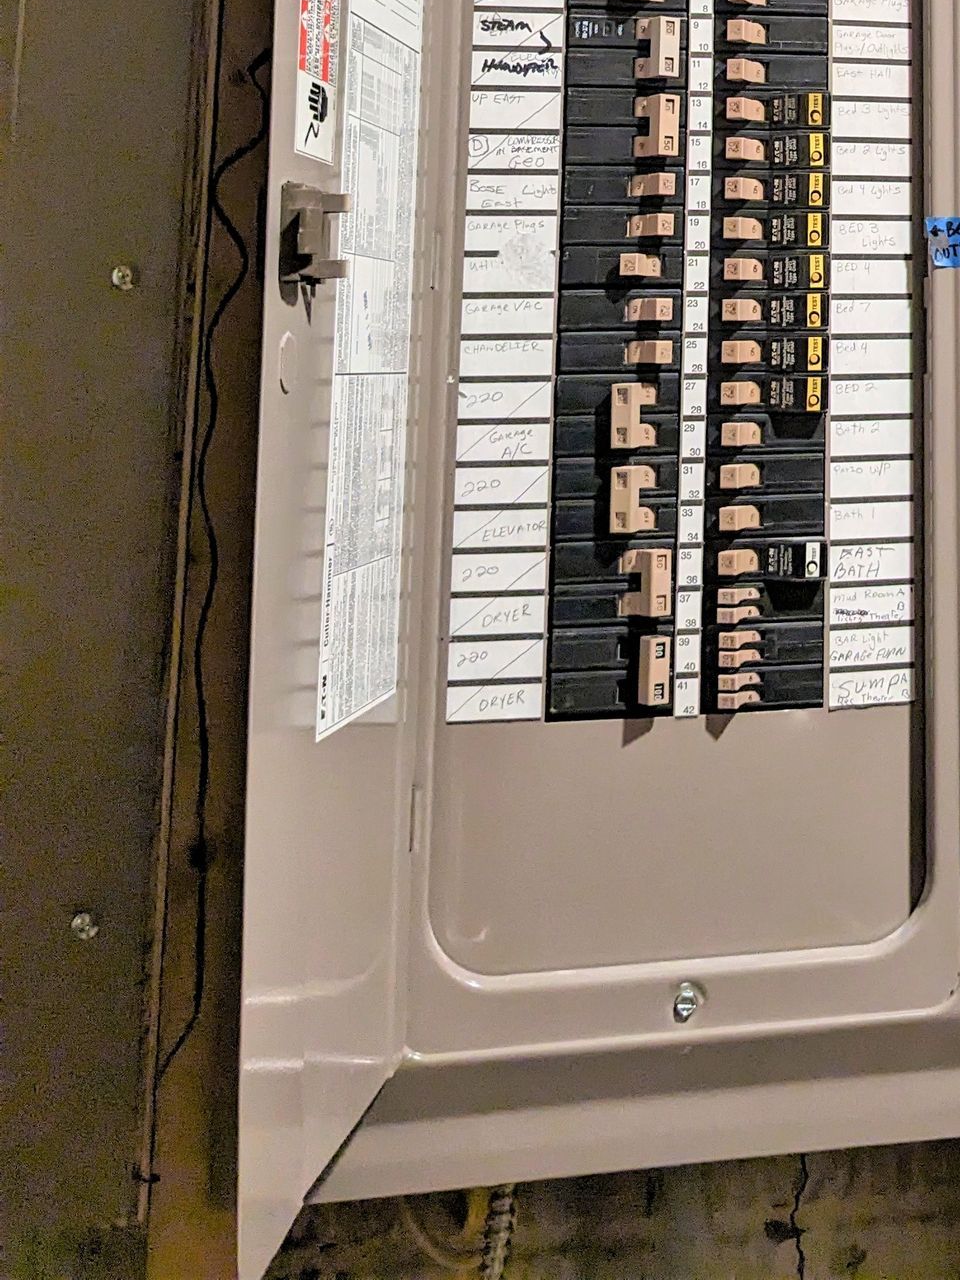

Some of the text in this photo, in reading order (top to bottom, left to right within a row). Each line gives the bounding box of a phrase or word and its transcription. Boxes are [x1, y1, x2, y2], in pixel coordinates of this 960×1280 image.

[480, 19, 532, 32] STEAM
[666, 22, 673, 34] 20
[665, 60, 671, 72] 20
[472, 94, 525, 104] UP EAST
[863, 104, 870, 114] 3
[664, 139, 671, 151] 50
[863, 146, 870, 155] 2
[840, 223, 879, 235] BED 3
[837, 261, 870, 274] BED 4
[515, 300, 543, 311] VAC
[836, 300, 854, 314] Bed
[836, 342, 868, 354] Bed 4
[836, 383, 878, 395] BED 2
[466, 391, 504, 408] 220
[870, 422, 880, 434] 2
[501, 443, 532, 460] A/C
[690, 448, 700, 456] 30
[683, 466, 693, 474] 31
[461, 479, 501, 497] 220
[689, 490, 699, 498] 32
[482, 521, 548, 542] ELEVATOR
[462, 566, 500, 583] 220
[834, 560, 881, 579] BATH
[896, 588, 905, 596] A
[679, 595, 690, 603] 37
[897, 601, 905, 611] B
[482, 603, 532, 627] DRYER
[685, 619, 696, 627] 38
[679, 638, 689, 646] 39
[835, 636, 858, 646] BAR
[457, 651, 488, 667] 220
[898, 673, 908, 684] A
[479, 689, 527, 711] DRYER
[683, 706, 694, 714] 42
